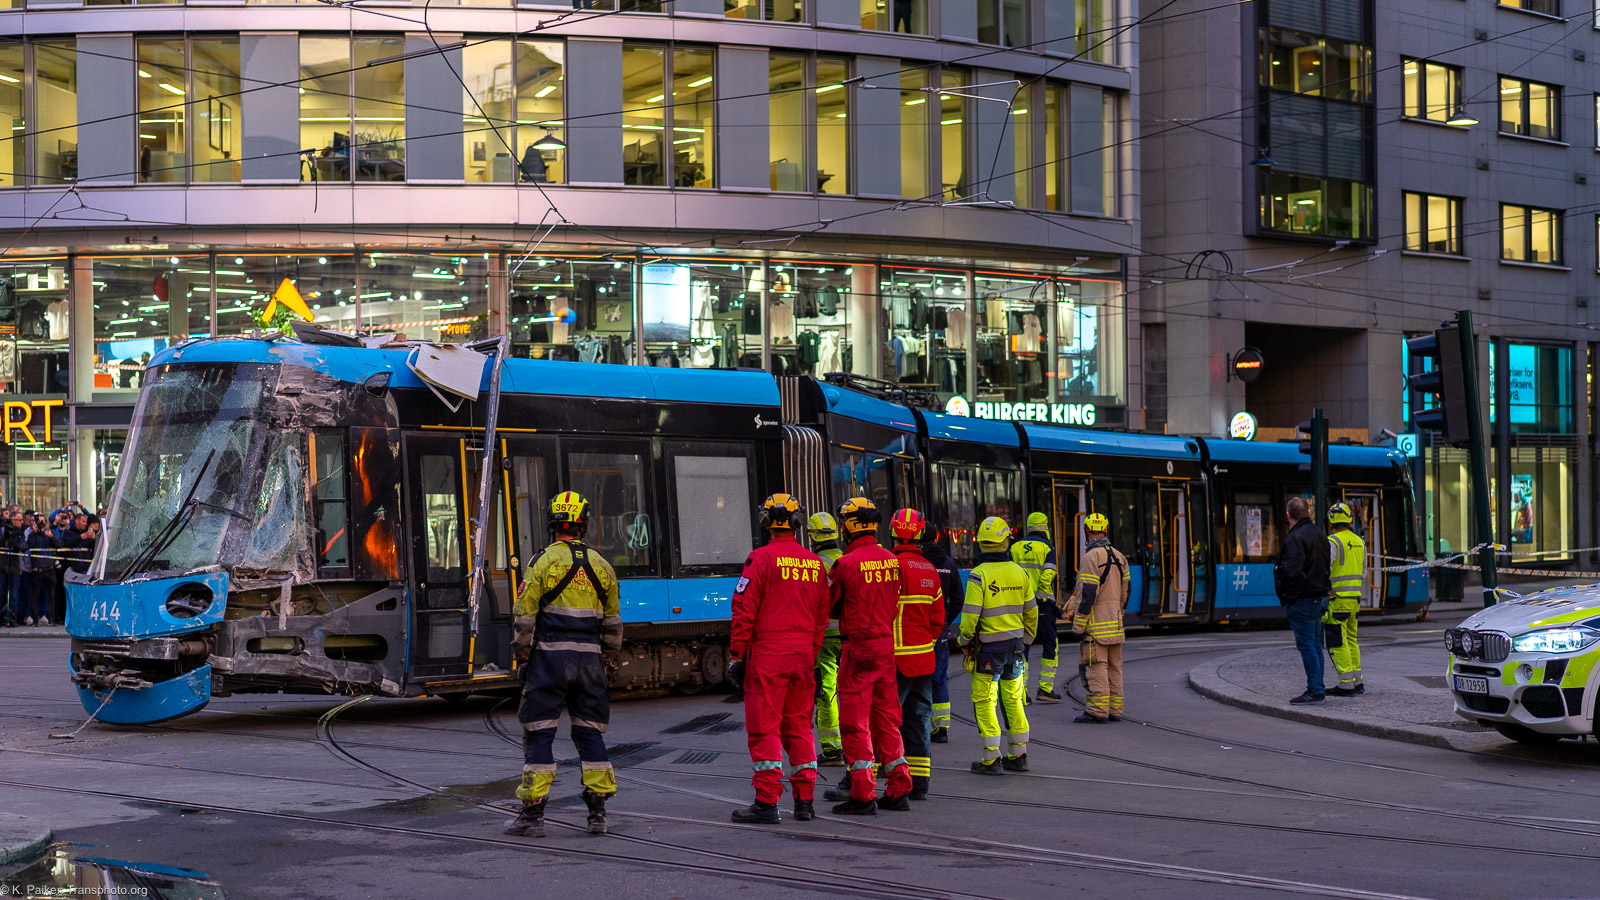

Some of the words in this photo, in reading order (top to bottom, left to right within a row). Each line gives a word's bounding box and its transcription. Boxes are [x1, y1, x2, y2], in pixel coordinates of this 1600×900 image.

[1525, 367, 1533, 377] for
[974, 402, 1049, 422] BURGER
[1051, 403, 1096, 426] KING
[0, 400, 64, 444] RT
[555, 503, 579, 513] 3672
[897, 521, 918, 532] 3046
[776, 556, 821, 571] AMBULANSE
[860, 558, 900, 572] AMBULANSE
[90, 601, 120, 621] 414
[1466, 679, 1486, 692] 12958
